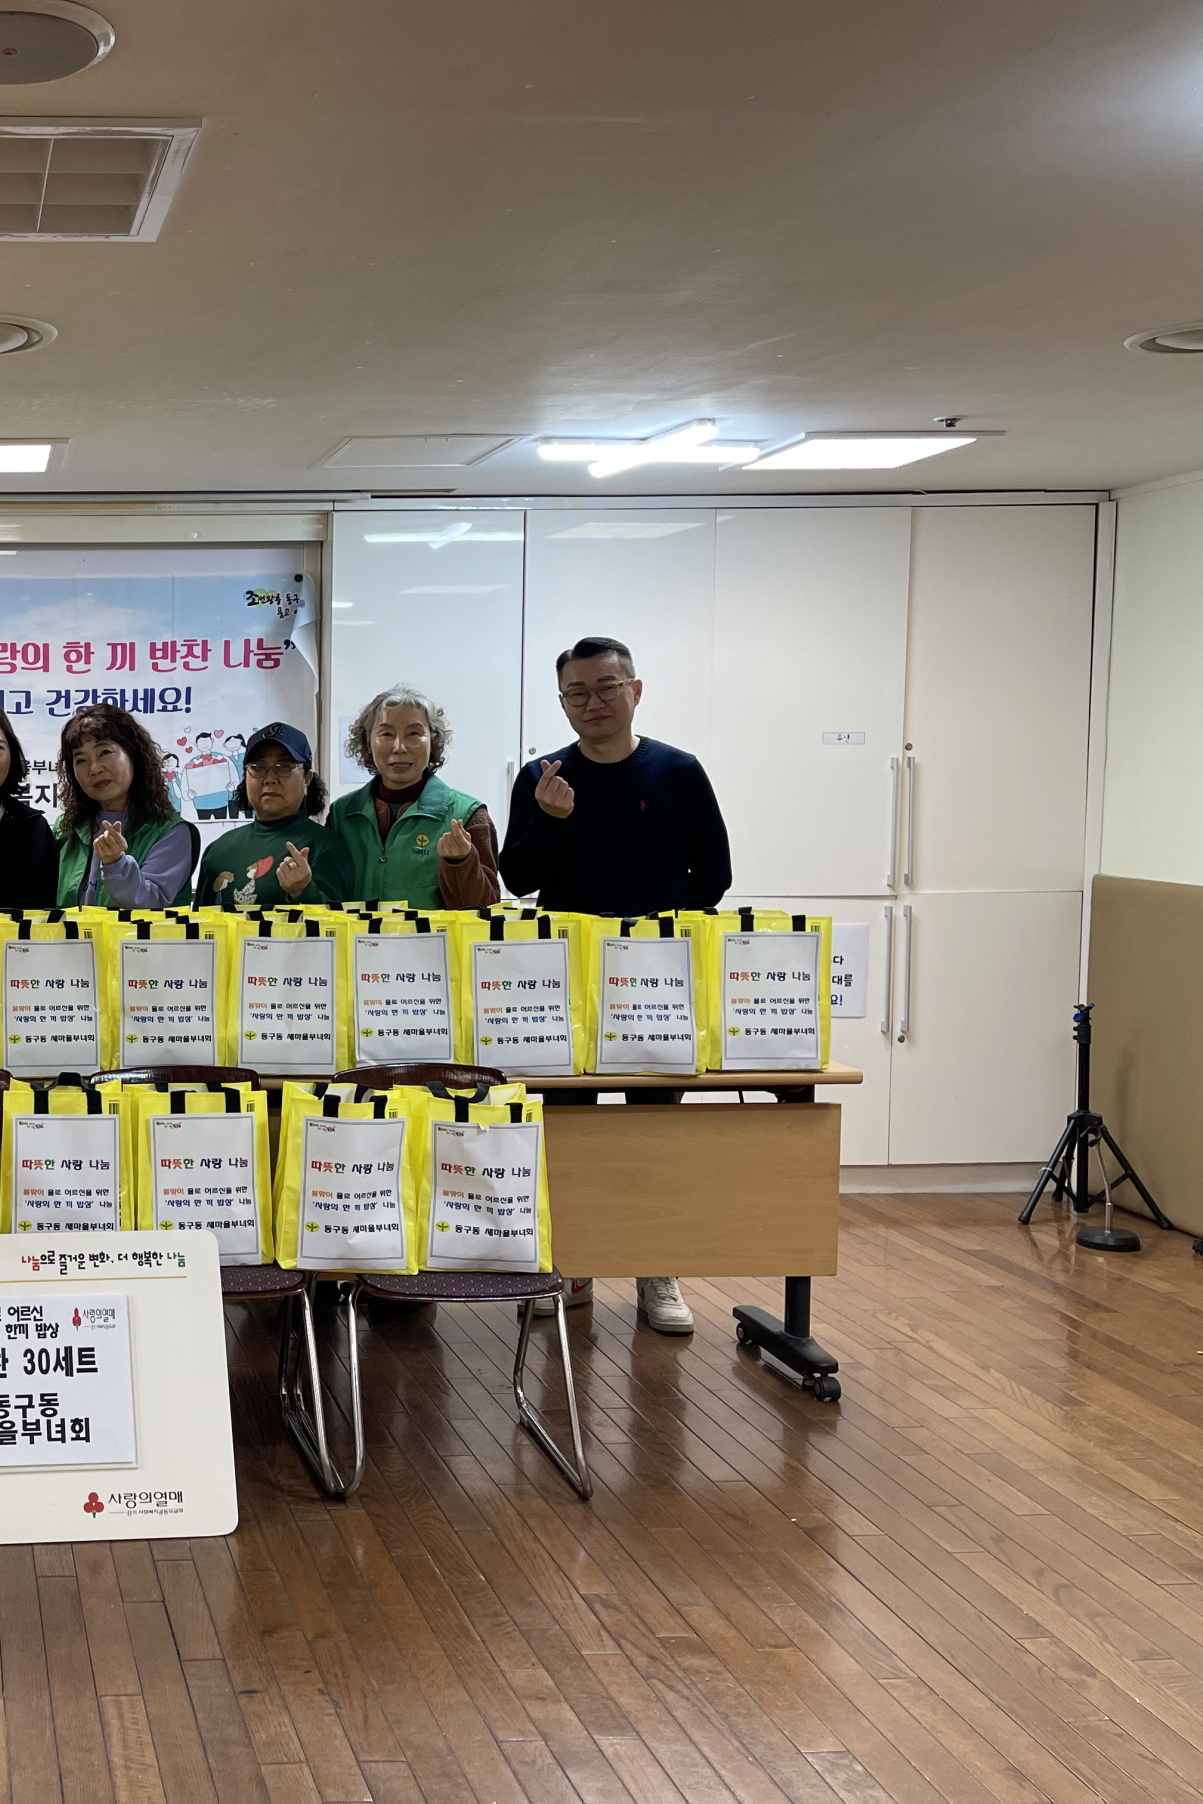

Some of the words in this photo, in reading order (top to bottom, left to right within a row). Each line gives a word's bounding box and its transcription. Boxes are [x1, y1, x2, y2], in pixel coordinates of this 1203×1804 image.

[63, 641, 94, 674] 한
[106, 641, 136, 672] 끼
[150, 639, 212, 672] 반찬
[223, 637, 296, 670] 나눔”
[46, 686, 192, 717] 건강하세요!
[248, 977, 278, 986] 따뜻한
[283, 977, 303, 987] 사랑
[309, 977, 327, 986] 나눔
[361, 973, 390, 982] 따뜻한
[396, 973, 416, 982] 사랑
[422, 972, 441, 982] 나눔
[609, 977, 637, 987] 따뜻한
[640, 978, 659, 988] 사랑
[664, 978, 684, 987] 나눔
[730, 972, 761, 981] 따뜻한
[766, 972, 786, 982] 사랑
[792, 972, 810, 981] 나눔
[10, 979, 40, 989] 따뜻한
[45, 979, 65, 989] 사랑
[71, 979, 90, 988] 나눔
[128, 980, 159, 989] 따뜻한
[164, 980, 184, 989] 사랑
[189, 979, 207, 988] 나눔
[481, 981, 512, 990] 따뜻한
[518, 980, 537, 990] 사랑
[542, 979, 560, 988] 나눔
[51, 1034, 94, 1042] 새마을부녀회
[22, 1159, 55, 1170] 따뜻한
[61, 1160, 83, 1170] 사랑
[89, 1160, 110, 1170] 나눔
[161, 1158, 194, 1169] 따뜻한
[200, 1158, 222, 1169] 사랑
[229, 1157, 248, 1168] 나눔
[311, 1161, 346, 1174] 따뜻한
[352, 1164, 373, 1174] 사랑
[378, 1162, 394, 1172] 나눔
[441, 1163, 476, 1176] 따뜻한
[482, 1167, 506, 1179] 사랑
[512, 1167, 531, 1177] 나눔
[37, 1223, 60, 1231] 동구동
[65, 1222, 114, 1231] 새마을부녀회
[178, 1222, 202, 1230] 동구동
[206, 1219, 254, 1229] 새마을부녀회
[324, 1225, 349, 1234] 동구동
[353, 1223, 399, 1233] 새마을부녀회
[455, 1225, 480, 1235] 동구동
[485, 1228, 533, 1237] 새마을부녀회
[21, 1251, 55, 1271] 나눔으로
[59, 1253, 86, 1275] 즐거운
[89, 1251, 114, 1268] 변화,
[118, 1253, 128, 1261] 더
[132, 1251, 163, 1268] 행복한
[167, 1252, 186, 1268] 나눔
[7, 1306, 44, 1322] 어르신
[82, 1308, 116, 1324] 사랑의열매
[5, 1324, 29, 1340] 한끼
[35, 1322, 59, 1339] 밥상
[23, 1346, 98, 1377] 30세트
[108, 1491, 183, 1509] 사랑의열매
